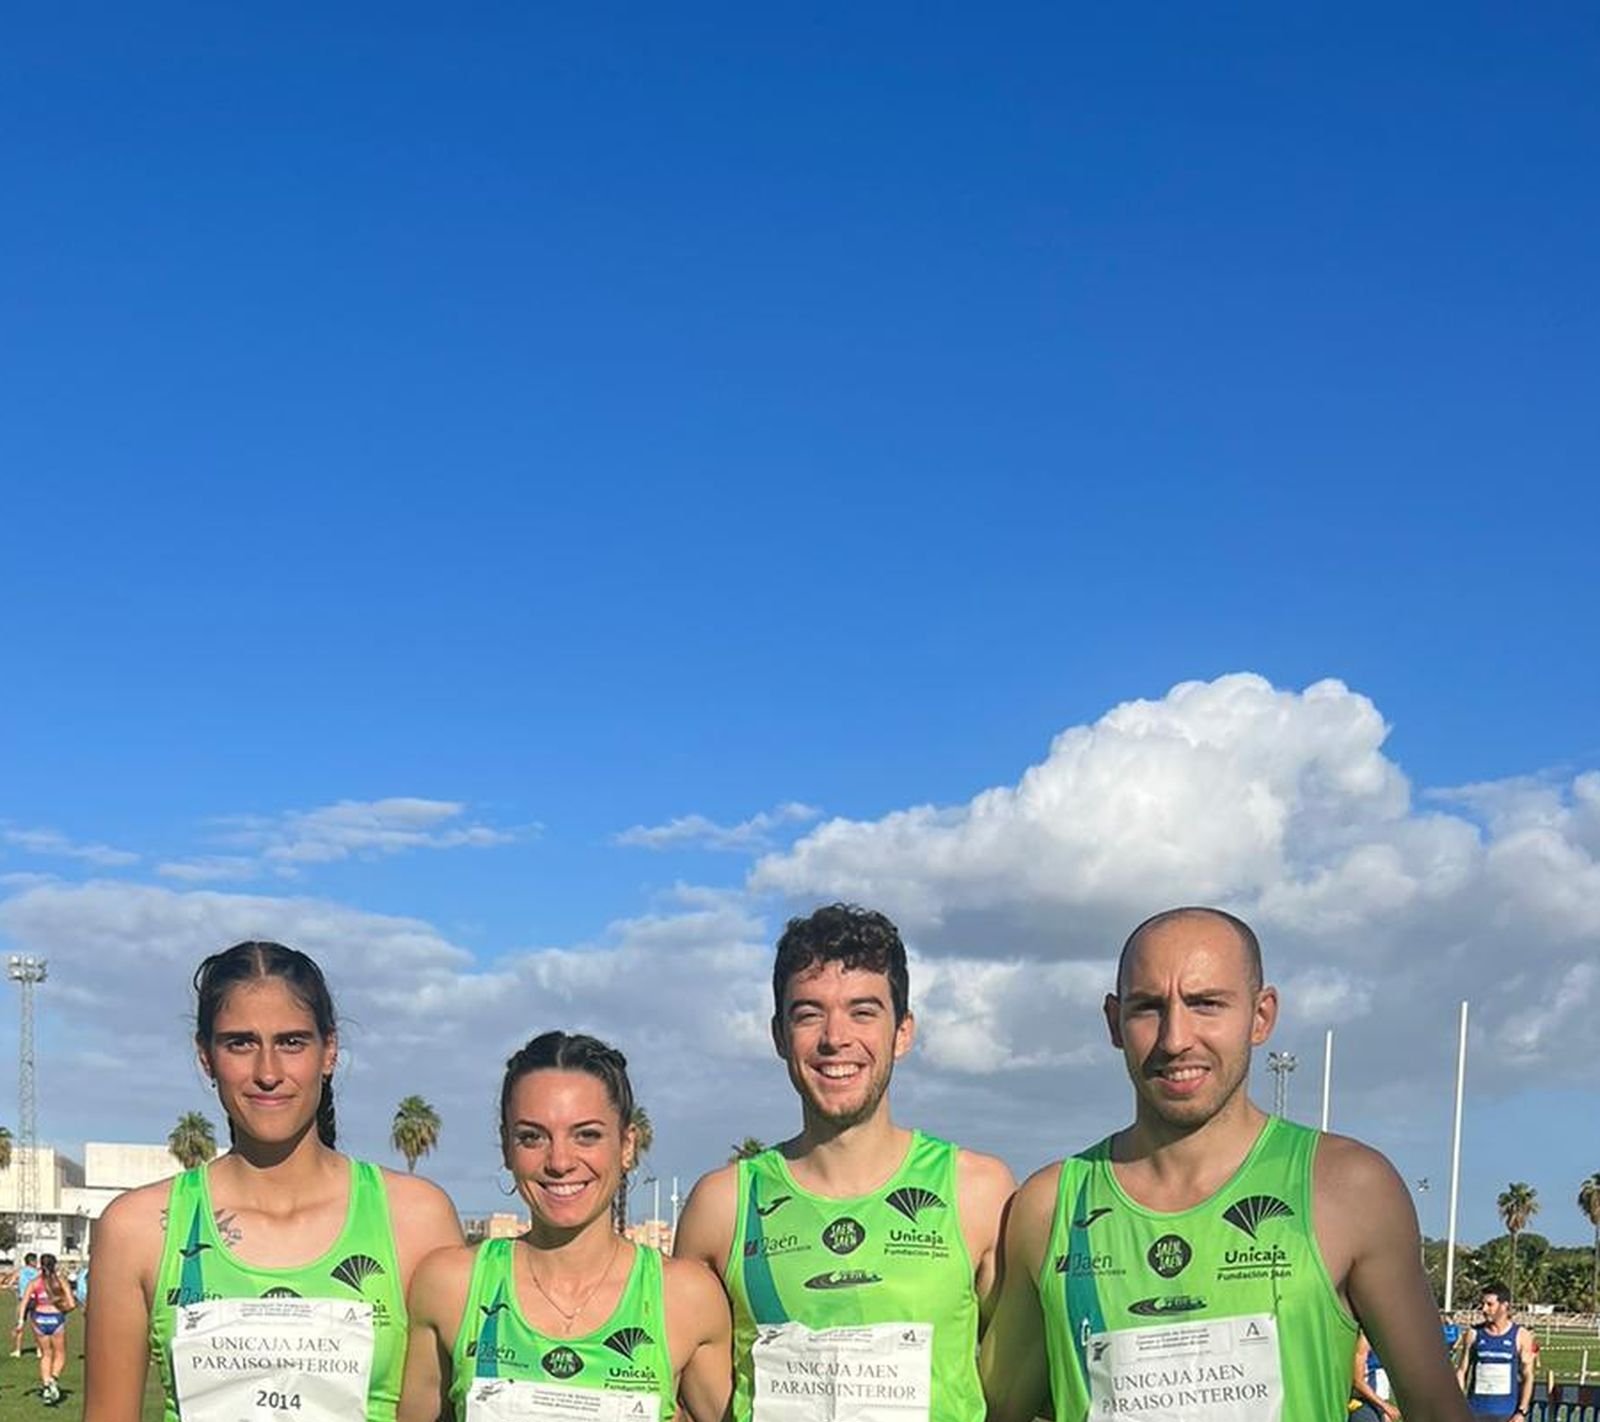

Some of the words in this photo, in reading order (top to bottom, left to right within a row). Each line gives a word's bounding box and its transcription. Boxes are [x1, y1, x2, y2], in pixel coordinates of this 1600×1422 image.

[890, 1229, 944, 1247] Unicaja
[1224, 1244, 1287, 1265] Unicaja
[211, 1336, 291, 1352] UNICAJA
[297, 1336, 342, 1352] JAEN
[192, 1356, 272, 1370] PARAISO
[276, 1357, 360, 1375] INTERIOR
[609, 1366, 656, 1381] Unicaja
[786, 1361, 851, 1378] UNICAJA
[856, 1363, 899, 1379] JAEN
[1113, 1369, 1192, 1392] UNICAJA
[1198, 1363, 1246, 1383] JAEN
[771, 1379, 835, 1396] PARAISO
[837, 1383, 917, 1400] INTERIOR
[1179, 1383, 1269, 1406] INTERIOR
[256, 1390, 302, 1410] 2014
